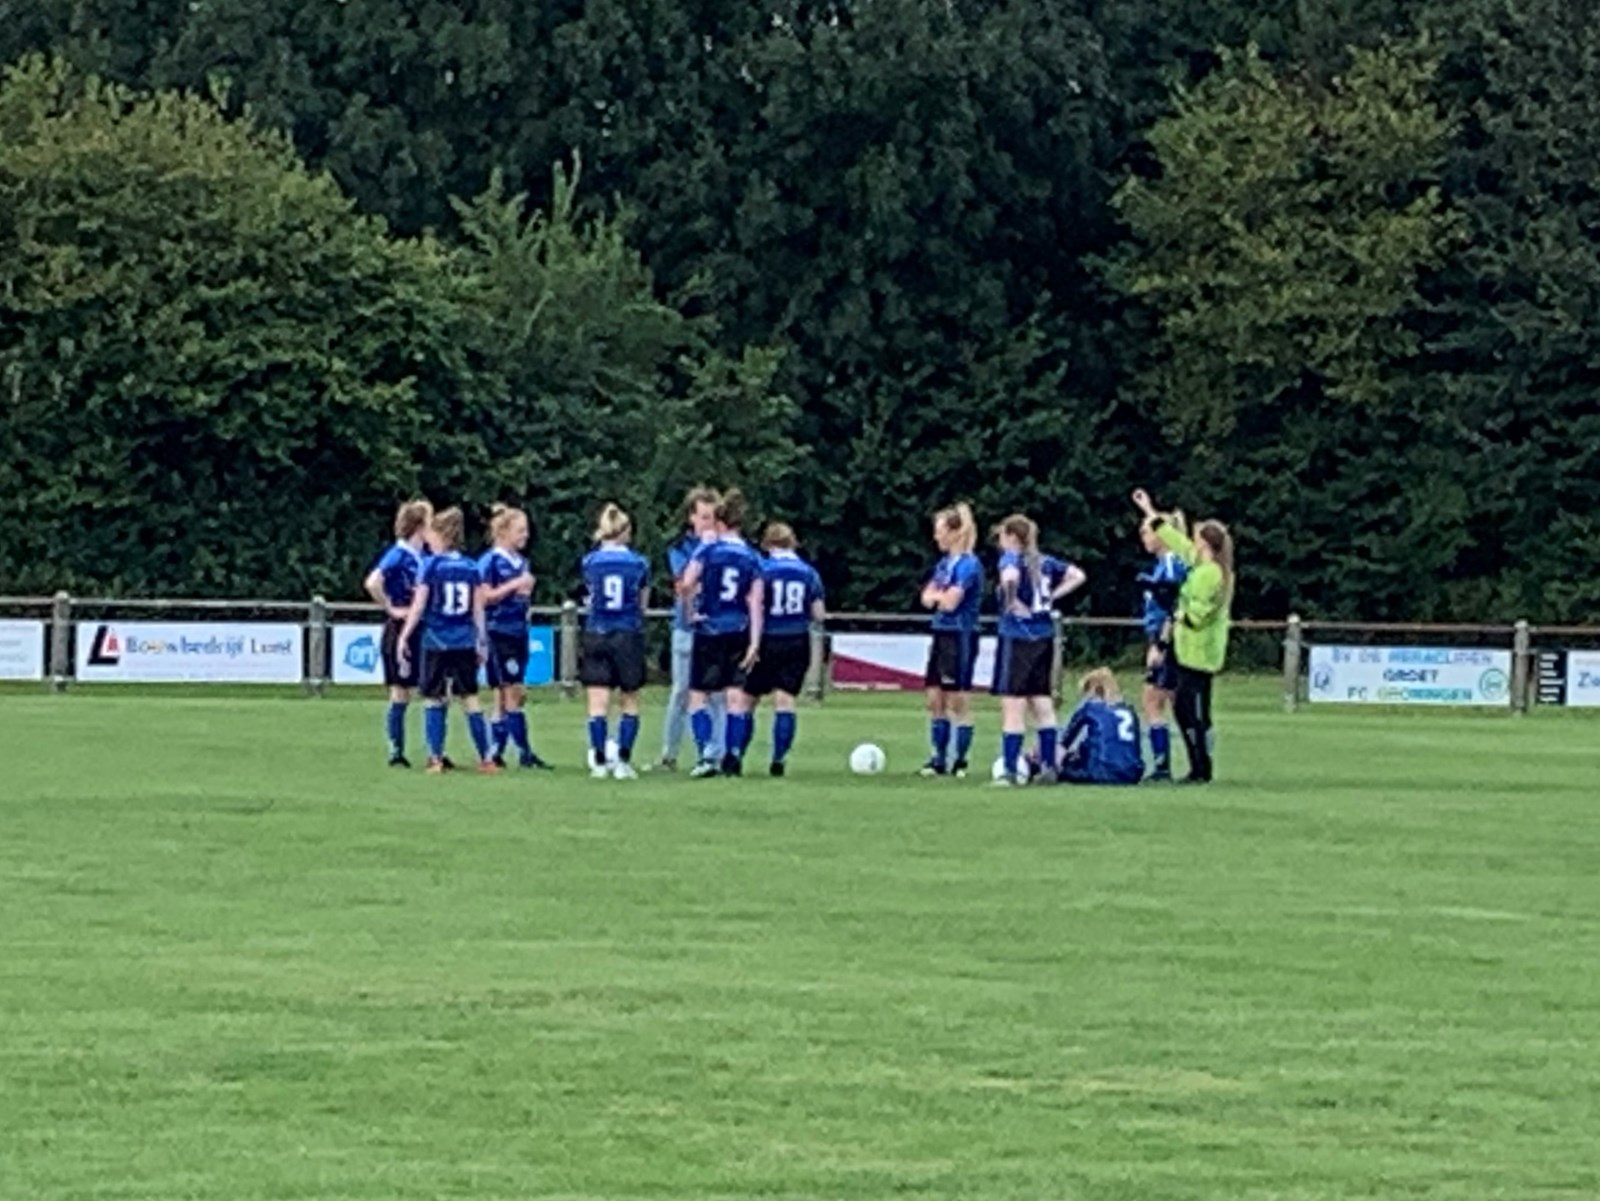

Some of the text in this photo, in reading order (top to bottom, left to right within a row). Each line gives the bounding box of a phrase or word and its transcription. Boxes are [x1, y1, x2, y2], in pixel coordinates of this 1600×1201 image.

[443, 581, 470, 616] 13
[603, 574, 625, 611] 9
[719, 566, 741, 601] 5
[769, 579, 806, 616] 18
[1113, 709, 1135, 742] 2
